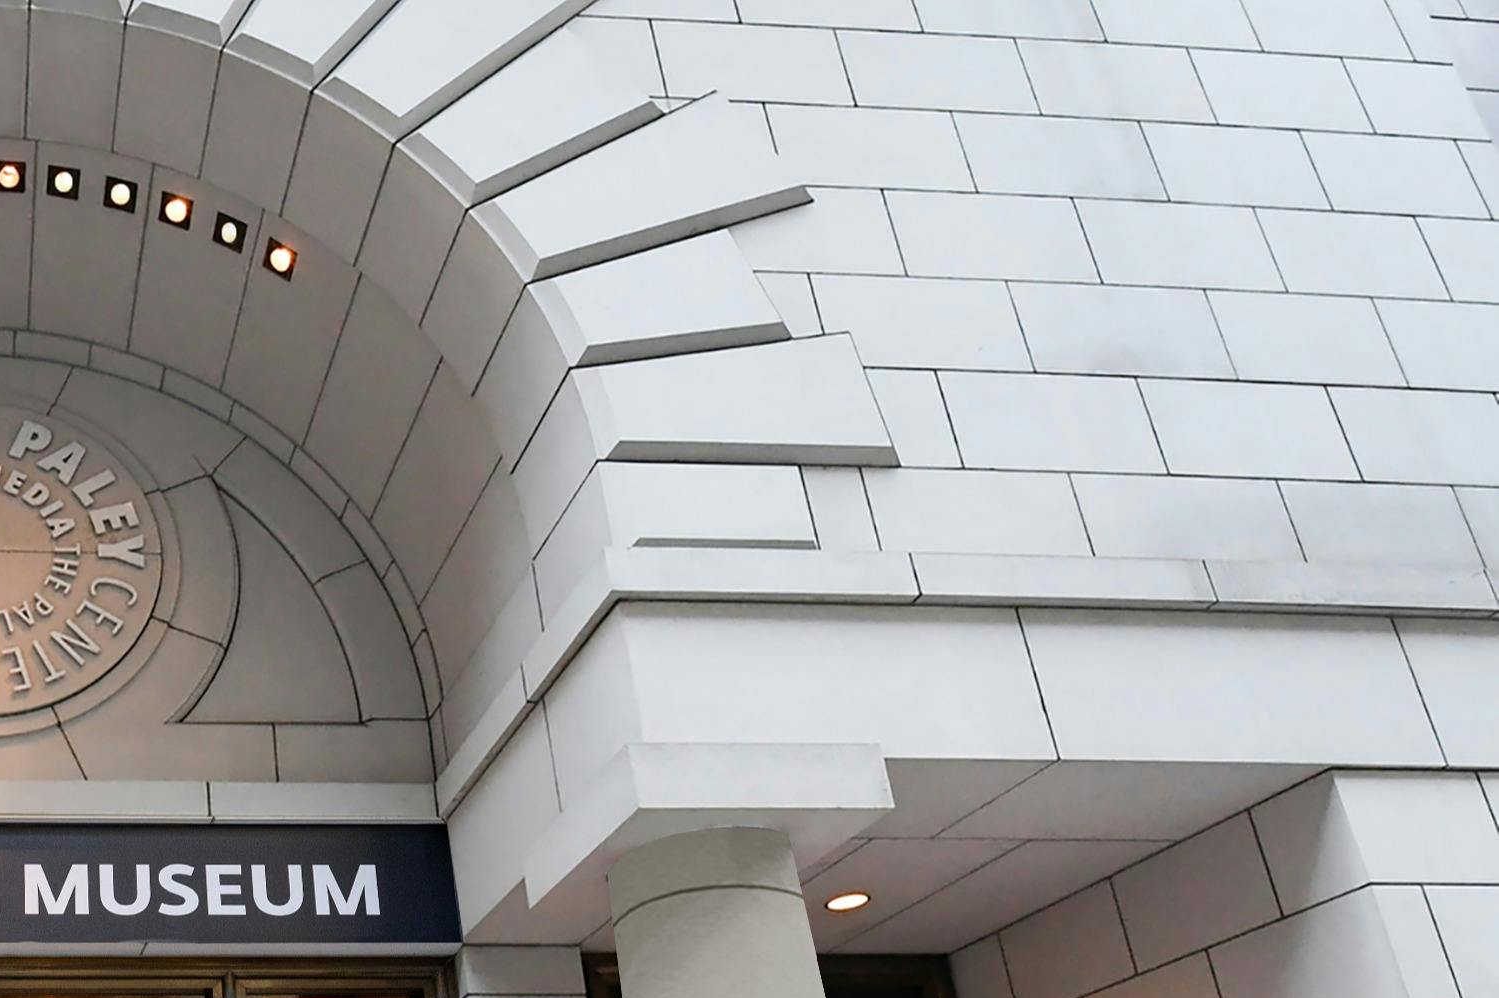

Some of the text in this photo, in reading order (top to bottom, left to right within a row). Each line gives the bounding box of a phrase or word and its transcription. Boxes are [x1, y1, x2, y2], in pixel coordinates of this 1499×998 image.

[9, 420, 146, 568] PALEY
[43, 543, 83, 595] THE
[24, 864, 380, 915] MUSEUM
